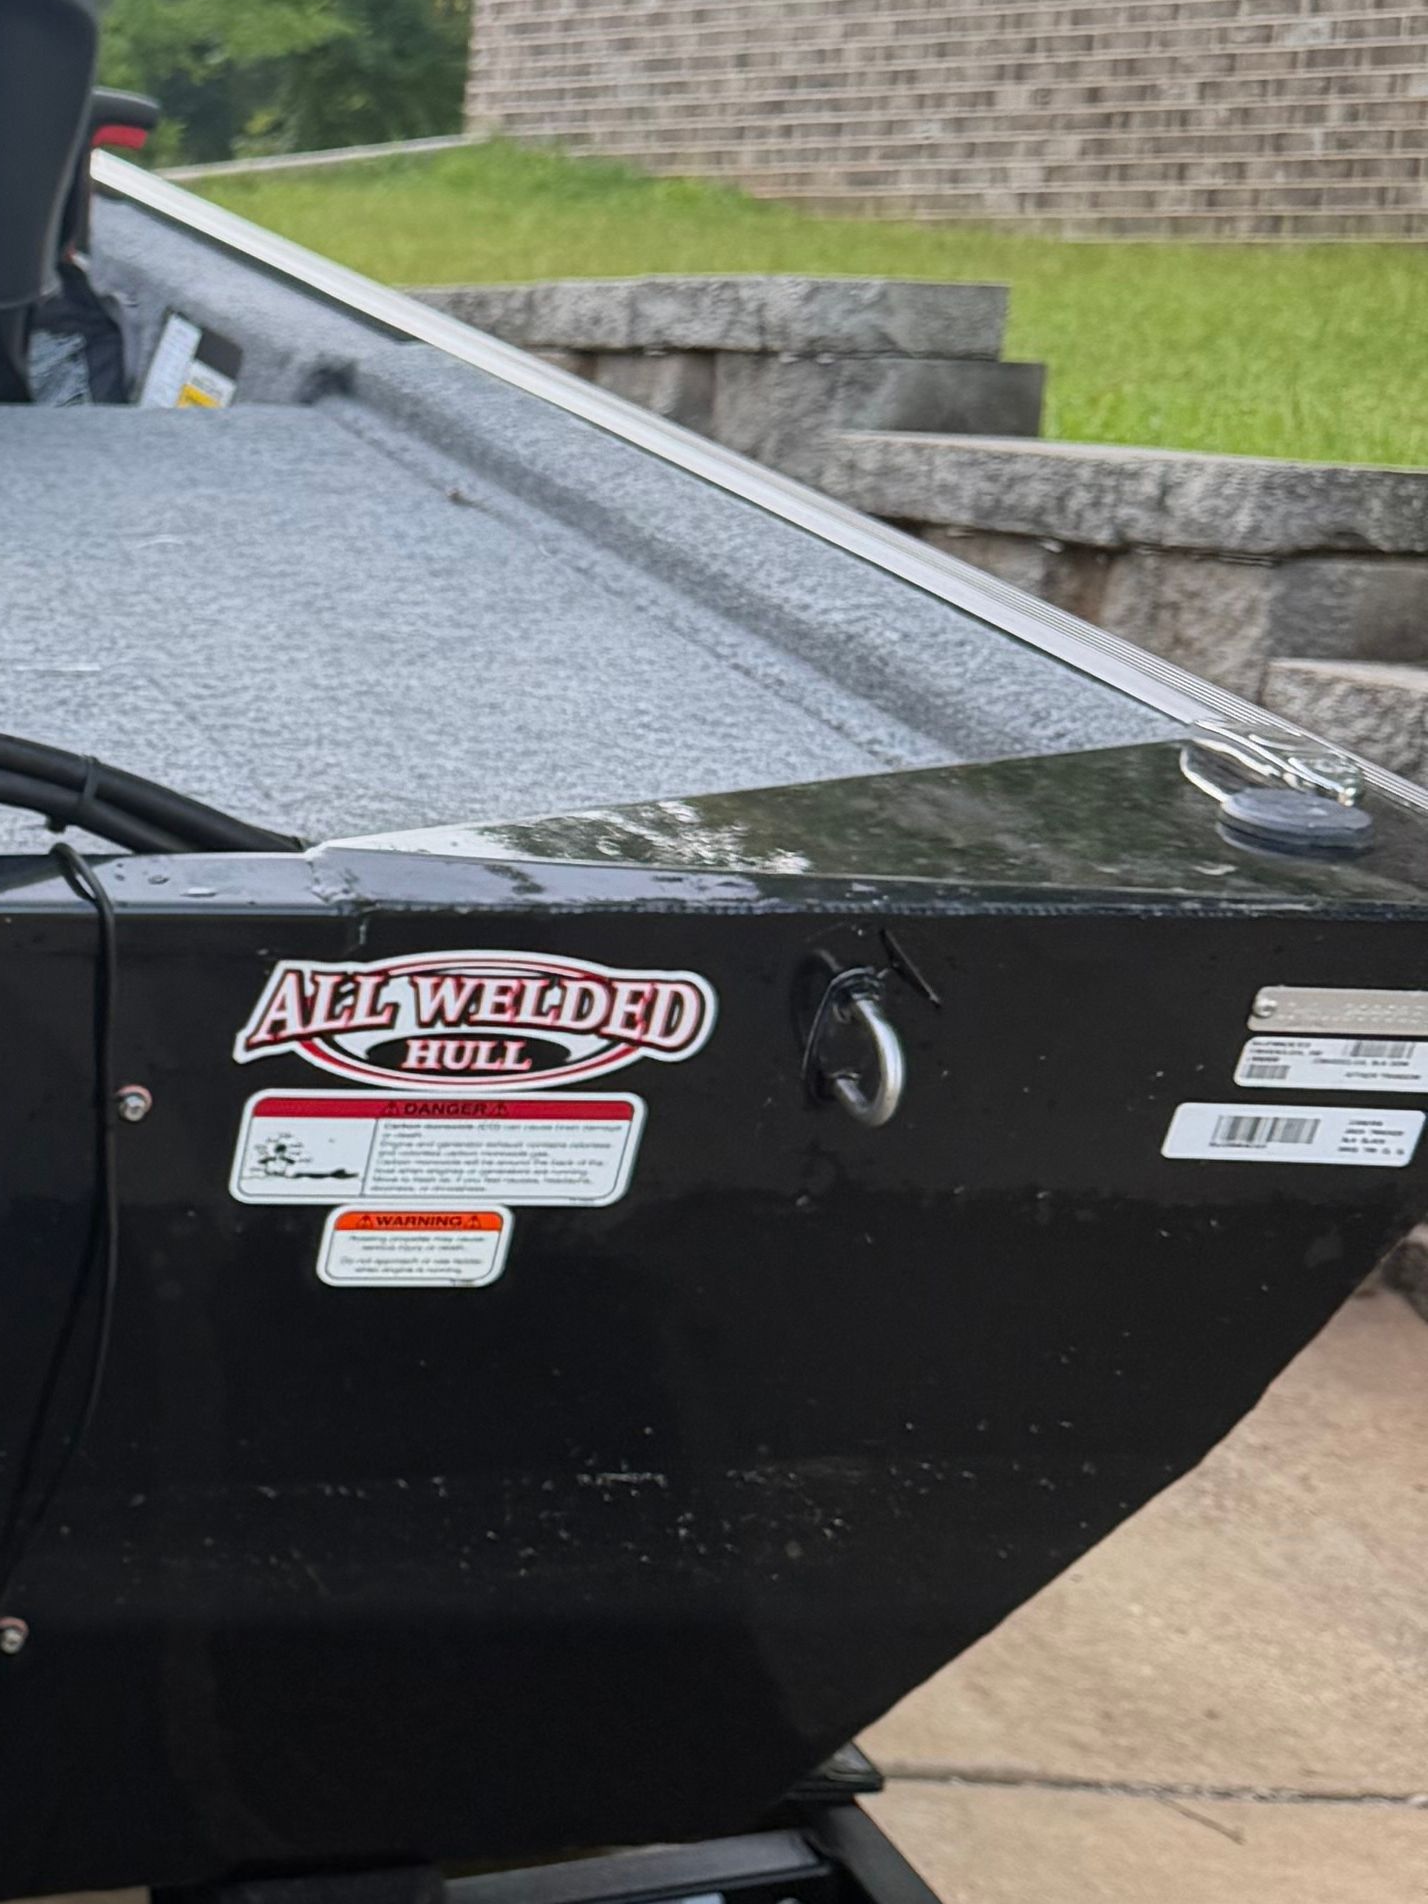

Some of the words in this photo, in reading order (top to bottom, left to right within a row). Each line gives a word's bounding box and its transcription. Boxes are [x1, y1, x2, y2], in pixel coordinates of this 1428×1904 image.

[246, 970, 397, 1050] ALL
[413, 973, 702, 1051] WELDED
[401, 1039, 533, 1071] HULL
[403, 1102, 487, 1117] DANGER
[375, 1215, 463, 1228] WARNING
